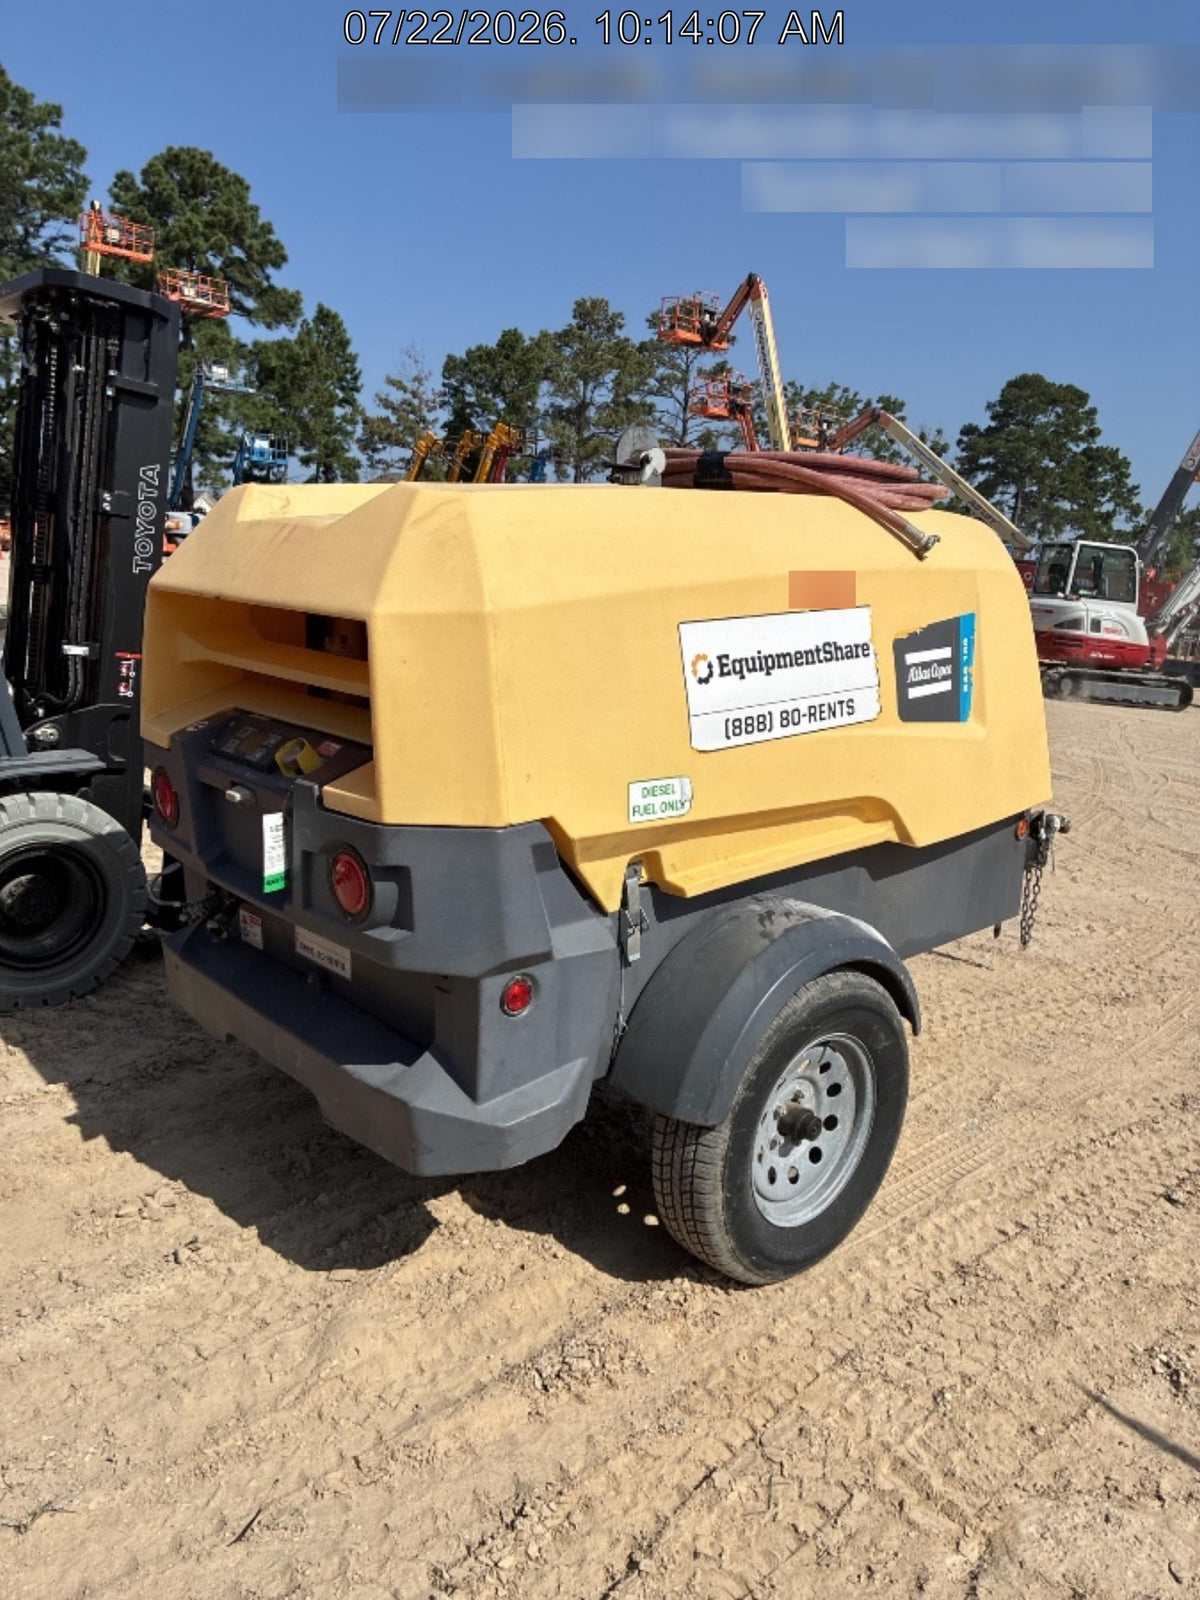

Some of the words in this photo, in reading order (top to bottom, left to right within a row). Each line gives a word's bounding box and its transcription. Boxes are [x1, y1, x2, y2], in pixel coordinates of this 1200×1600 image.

[132, 463, 160, 574] TOYOTA
[716, 641, 870, 680] EquipmentShare
[906, 665, 931, 683] Atlas
[724, 710, 773, 740] (888)
[780, 698, 855, 728] 80-RENTS
[641, 783, 676, 799] DIESEL
[632, 803, 657, 817] FUEL
[660, 799, 688, 813] ONLY
